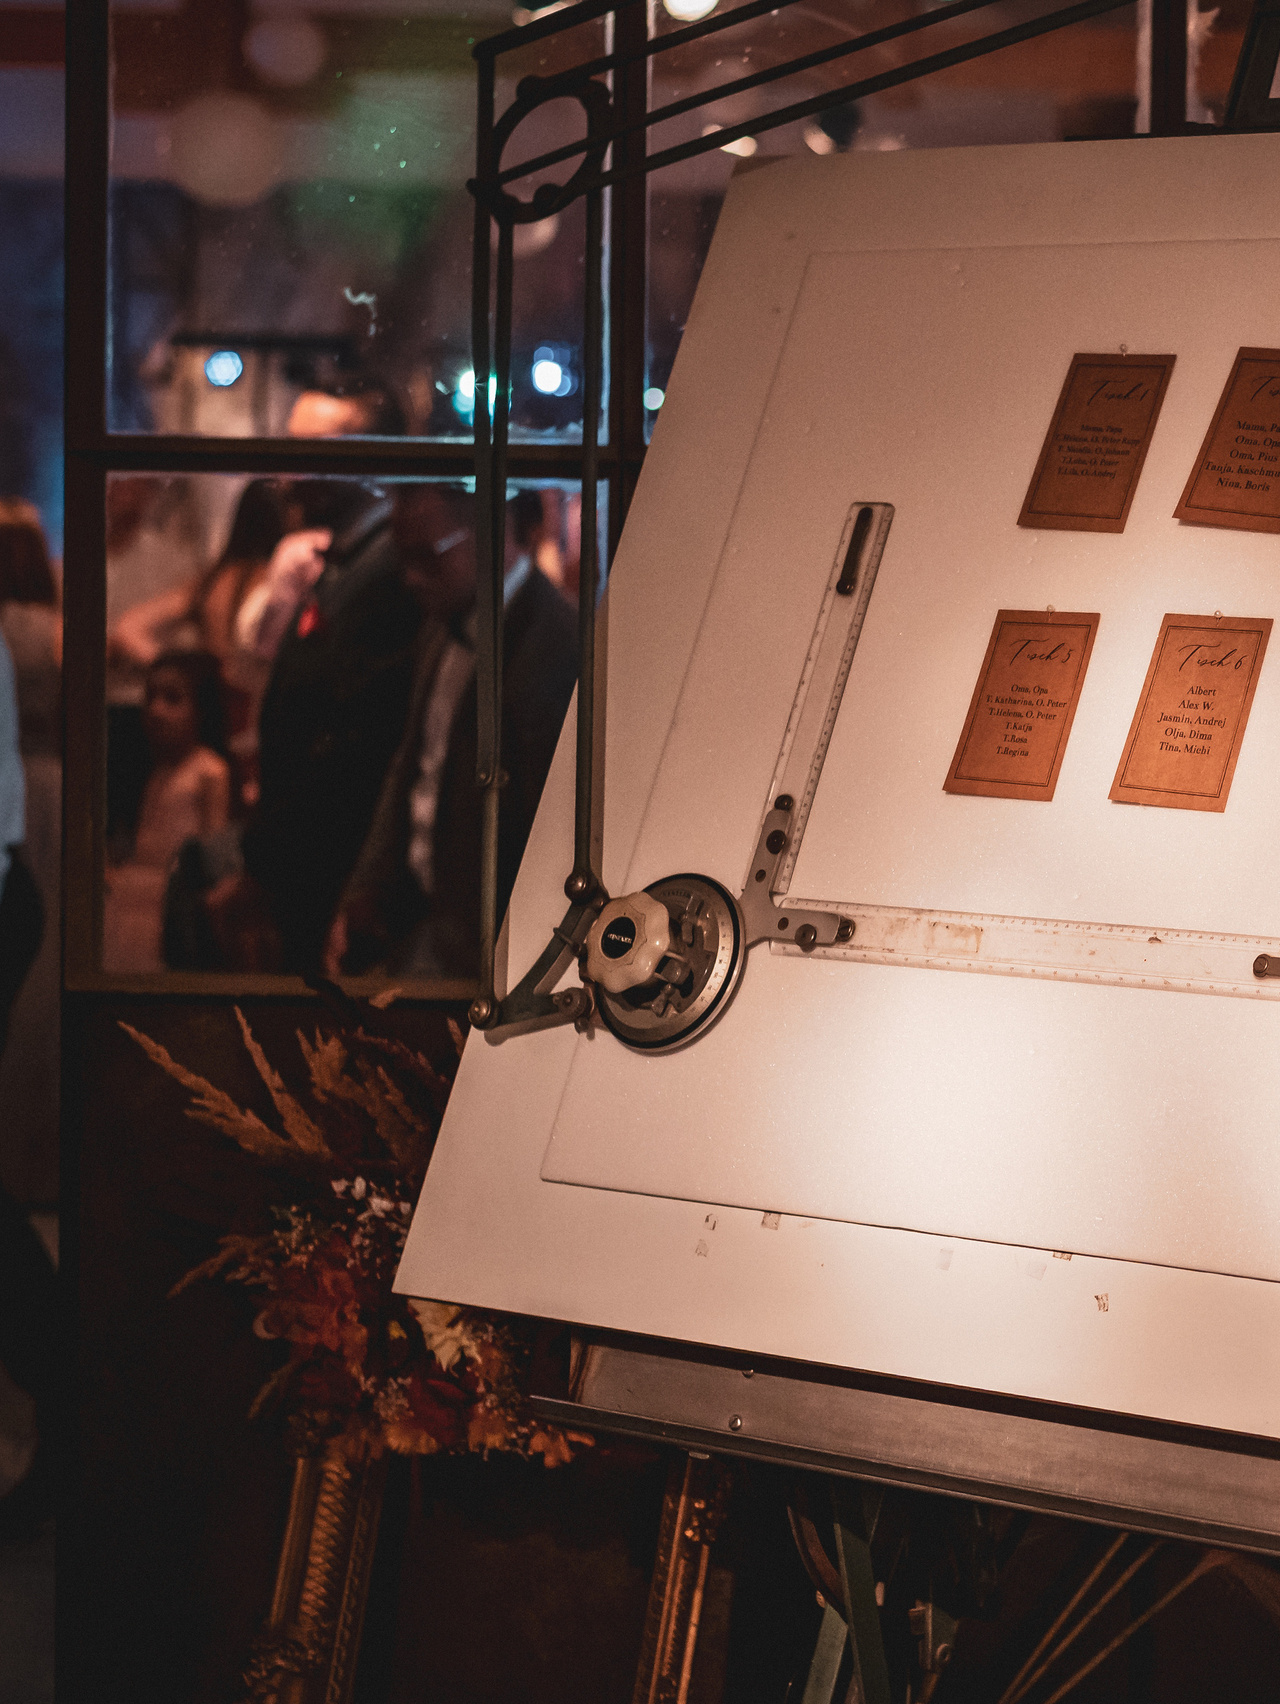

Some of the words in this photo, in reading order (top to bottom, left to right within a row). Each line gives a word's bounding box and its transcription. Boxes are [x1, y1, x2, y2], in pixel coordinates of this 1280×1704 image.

[1087, 378, 1143, 406] Tisch
[1237, 421, 1267, 432] Mama,
[1235, 435, 1260, 446] Oma,
[1230, 449, 1255, 461] Oma,
[1258, 452, 1278, 462] Pius
[1205, 461, 1234, 474] Tanja,
[1217, 477, 1242, 489] Nina,
[1245, 480, 1270, 491] Boris
[1010, 638, 1065, 666] Tisch
[1061, 648, 1074, 664] 5
[1178, 641, 1237, 672] Tisch
[1234, 655, 1247, 670] 6
[1011, 684, 1031, 694] Oma,
[1033, 685, 1048, 695] Opa
[1187, 686, 1216, 696] Albert
[995, 696, 1034, 706] Katharina,
[1047, 699, 1067, 708] Peter
[1178, 700, 1199, 709] Alex
[1203, 702, 1214, 710] W.
[1037, 712, 1057, 720] Peter
[1157, 713, 1192, 724] Jasmin,
[1194, 716, 1227, 728] Andrej
[1165, 727, 1186, 739] Olja,
[1189, 730, 1213, 740] Dima
[1159, 742, 1181, 752] Tina,
[1184, 744, 1211, 754] Michi
